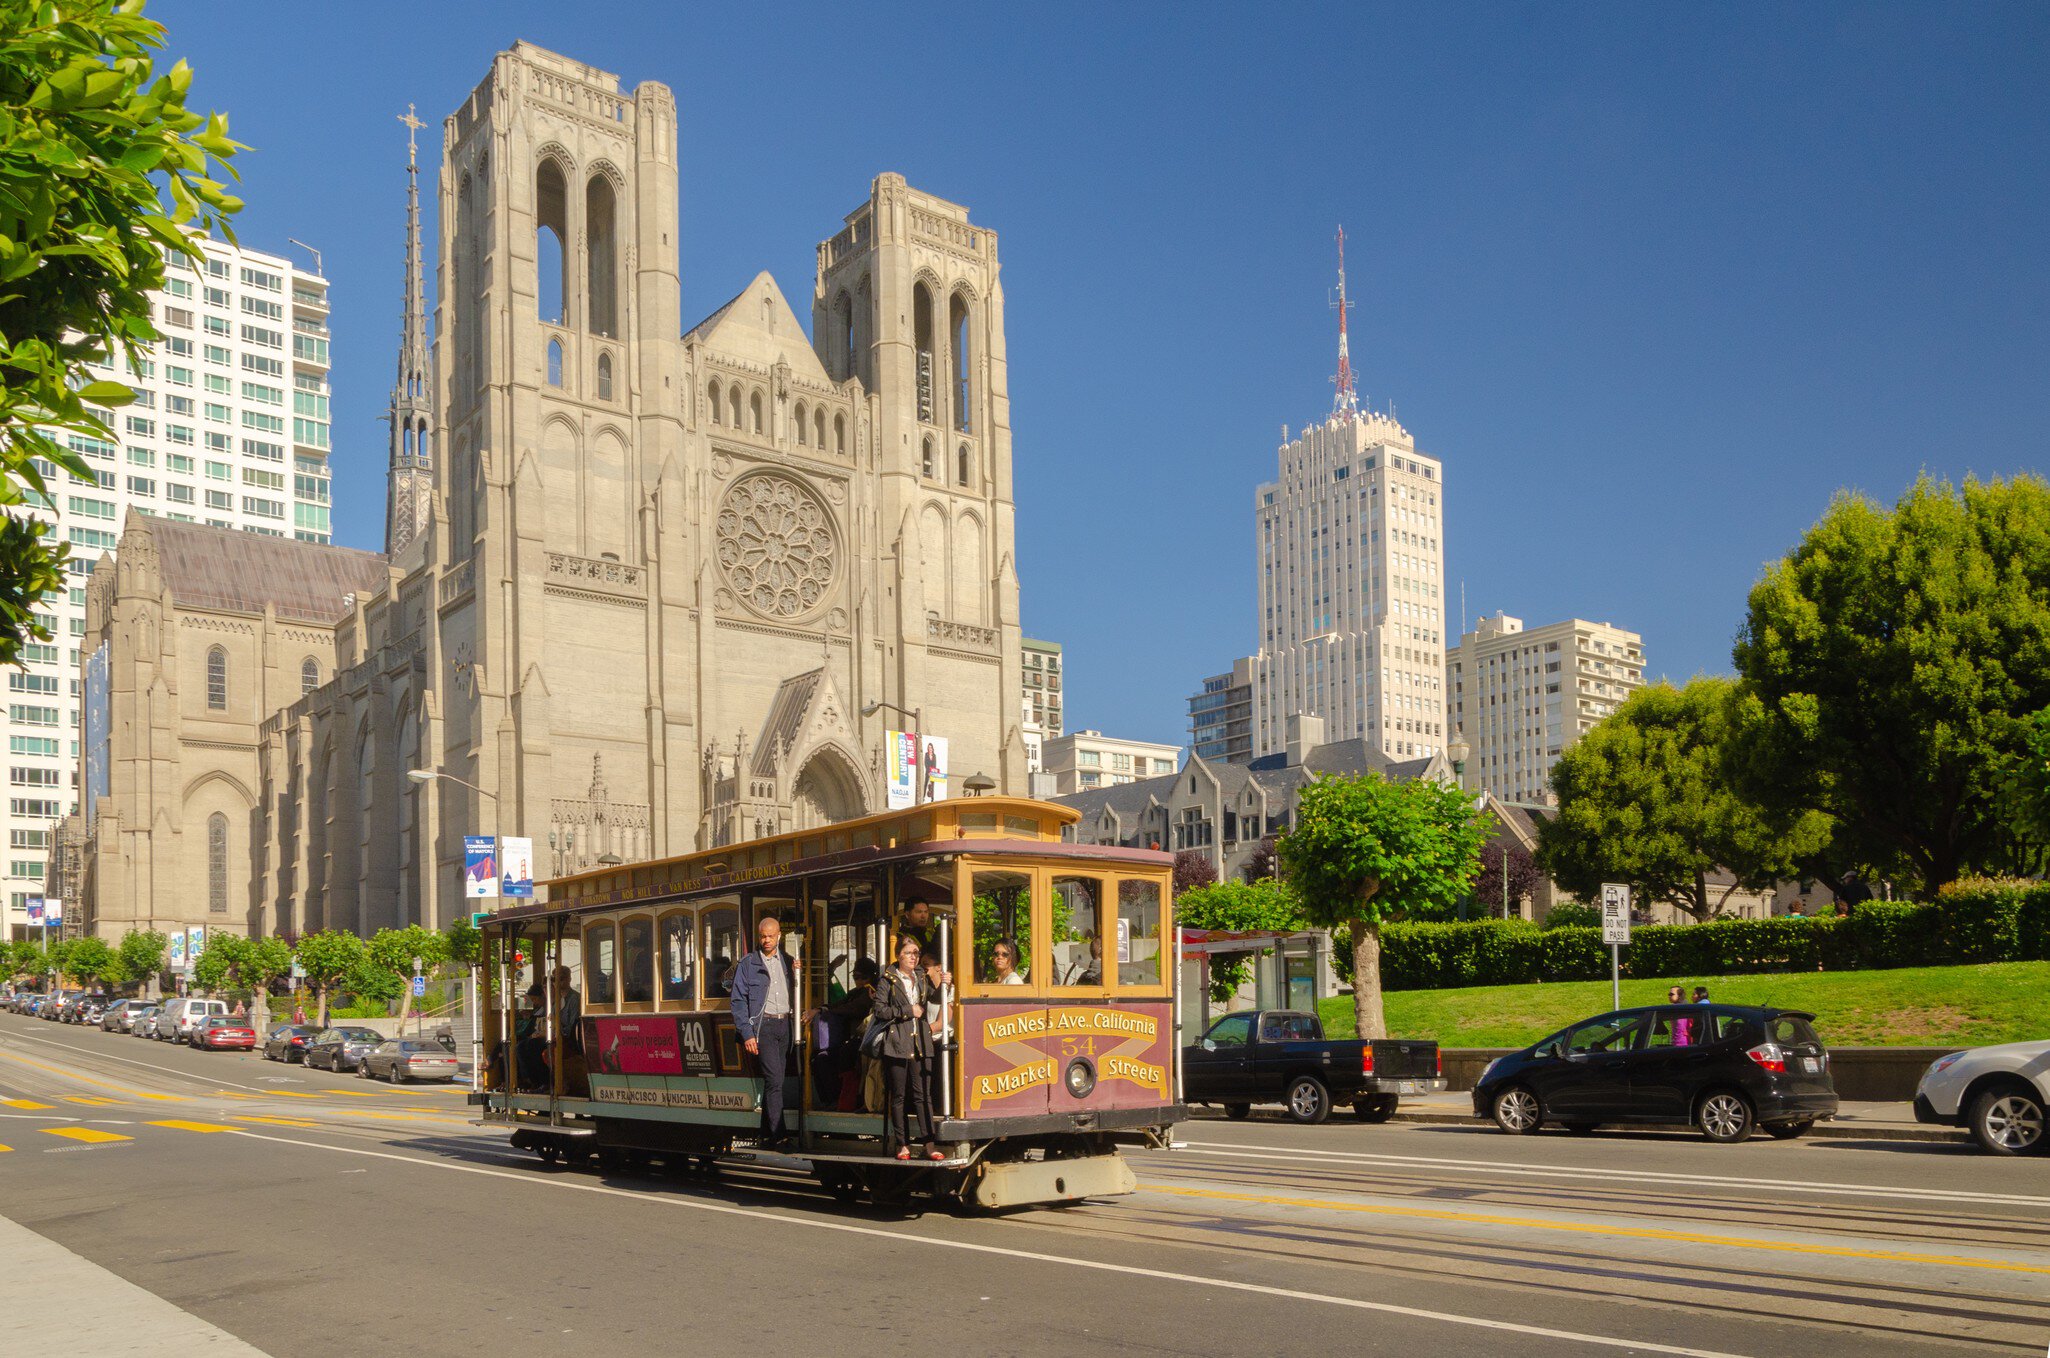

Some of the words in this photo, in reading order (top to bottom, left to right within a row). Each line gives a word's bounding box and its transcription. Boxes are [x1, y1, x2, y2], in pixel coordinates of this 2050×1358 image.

[899, 738, 909, 777] CENTURY
[907, 739, 915, 759] NEW
[621, 887, 634, 900] NOB
[637, 886, 652, 898] HILL
[668, 881, 683, 893] VAN
[683, 879, 701, 891] NESS
[730, 866, 778, 884] CALIFORNIA
[1605, 918, 1614, 928] DO
[1616, 919, 1627, 929] NOT
[1609, 930, 1625, 940] PASS
[987, 1019, 1016, 1040] Van
[1017, 1014, 1054, 1037] Ness
[1093, 1012, 1156, 1036] California
[622, 1035, 645, 1048] simply
[646, 1035, 674, 1048] prepaid
[1061, 1036, 1097, 1057] 54
[980, 1078, 993, 1095] &
[996, 1063, 1052, 1093] Market
[1108, 1058, 1160, 1083] Streets
[600, 1089, 615, 1099] SAN
[616, 1090, 657, 1102] FRANCISCO
[661, 1092, 703, 1105] MUNICIPAL
[707, 1094, 745, 1107] RAILWAY
